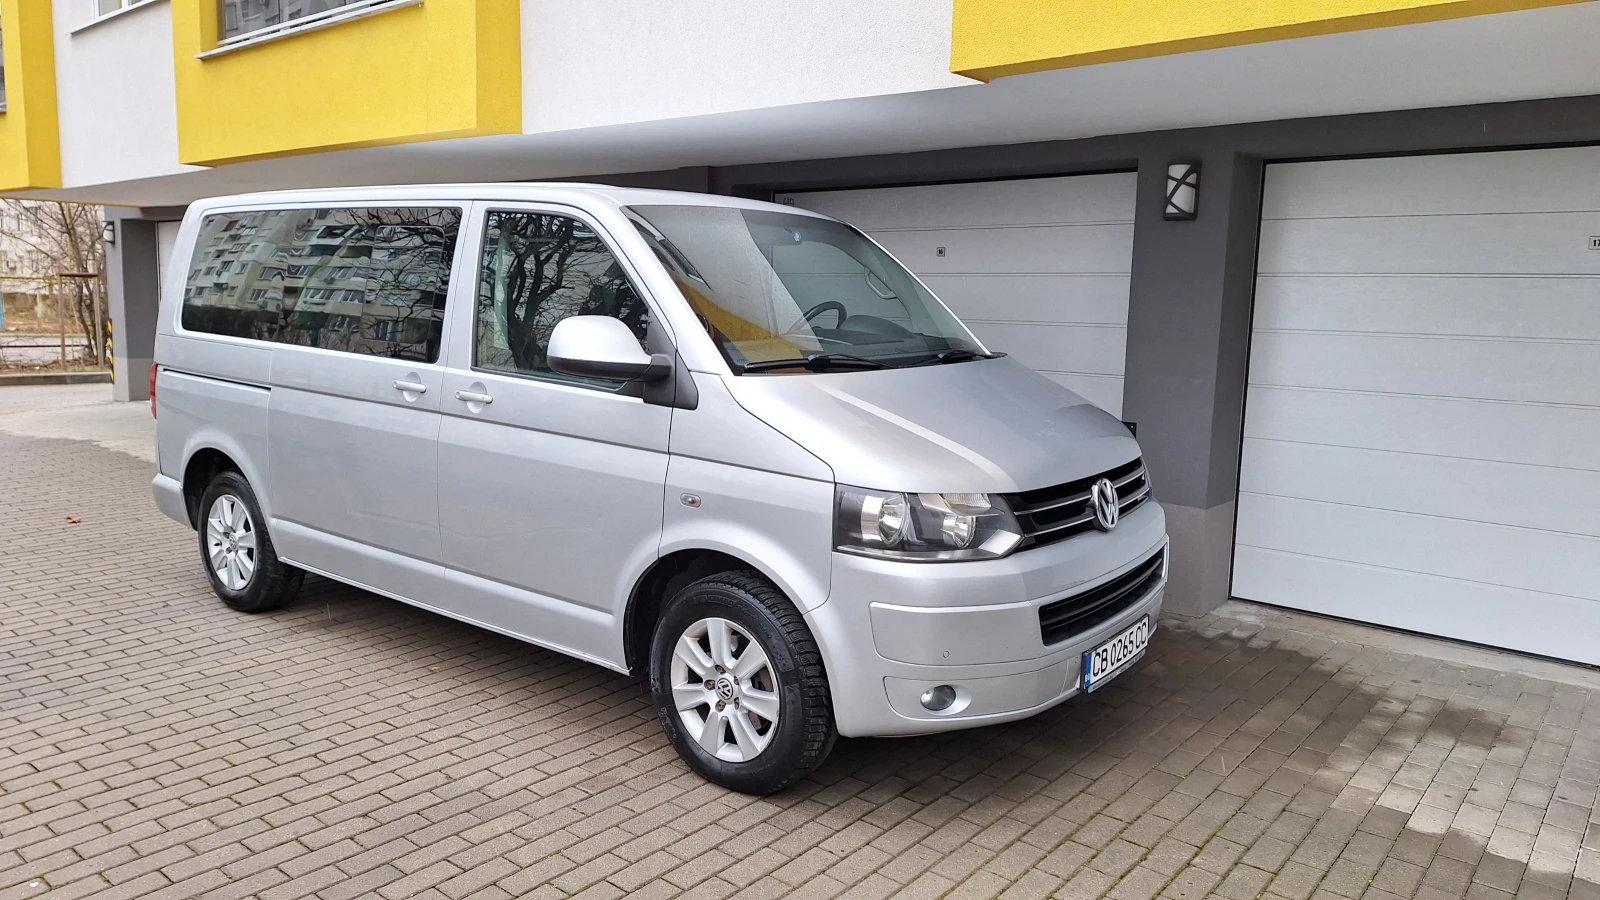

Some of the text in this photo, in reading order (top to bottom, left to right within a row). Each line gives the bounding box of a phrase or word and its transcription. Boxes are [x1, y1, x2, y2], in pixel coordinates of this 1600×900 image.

[1097, 478, 1119, 528] VW
[1092, 648, 1108, 677] CB
[1110, 631, 1134, 667] 0265
[1135, 621, 1147, 650] CC
[716, 677, 734, 700] VW
